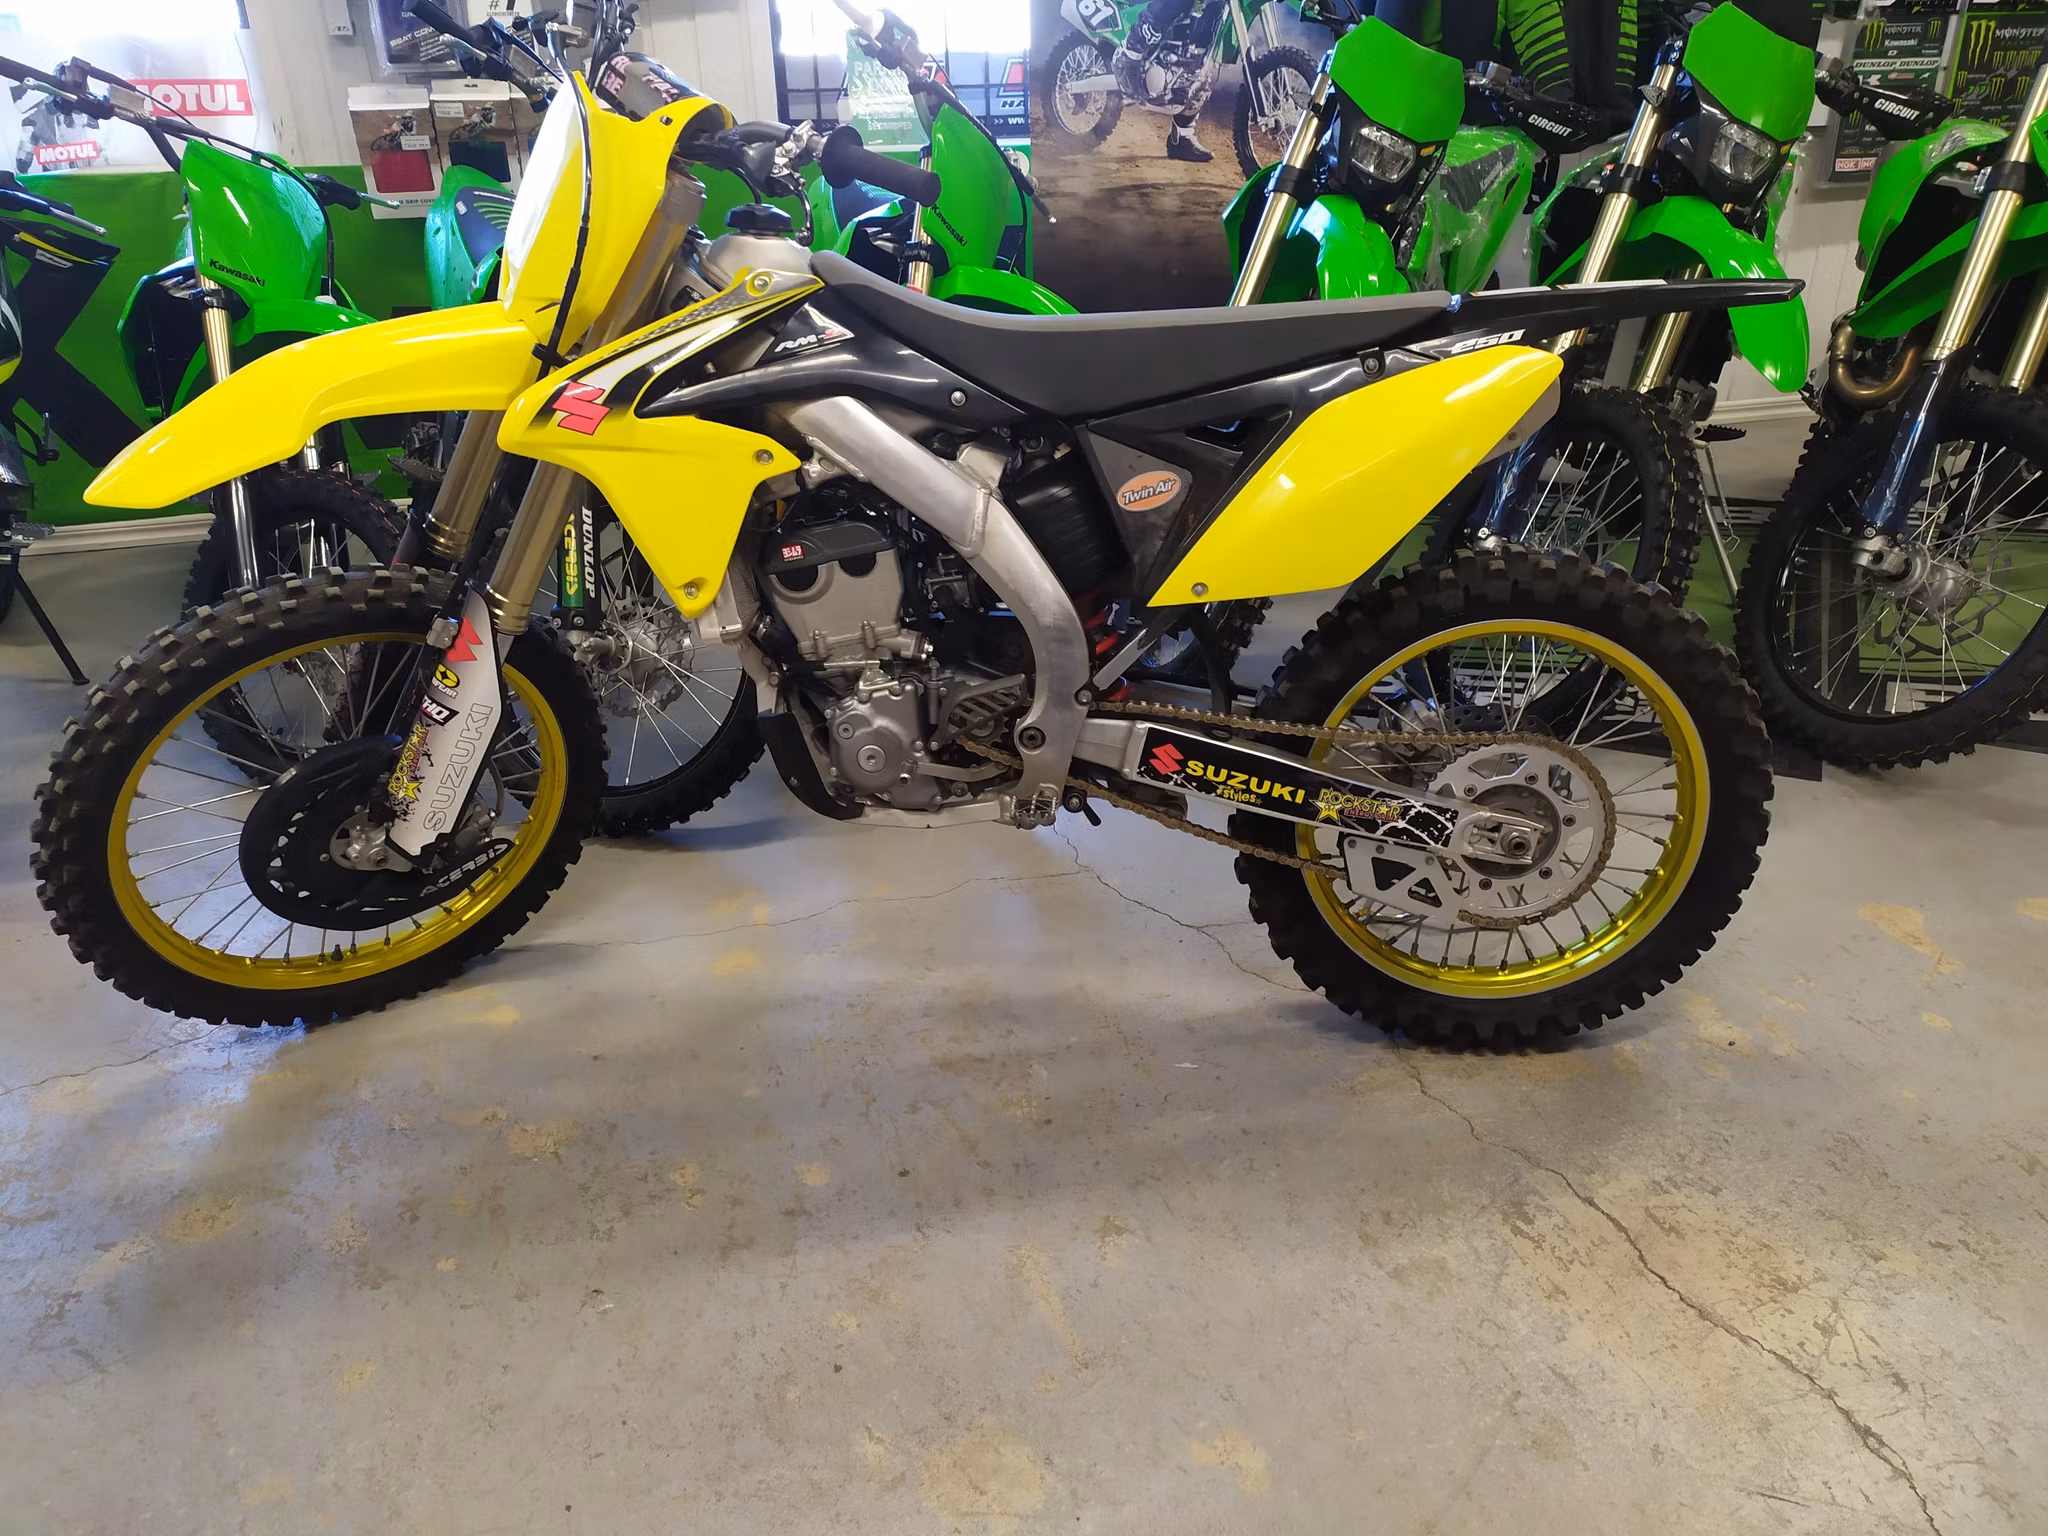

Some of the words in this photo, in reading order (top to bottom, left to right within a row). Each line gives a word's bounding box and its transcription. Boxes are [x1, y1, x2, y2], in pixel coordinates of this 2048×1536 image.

[1884, 38, 1918, 47] Kawasaki
[1855, 60, 1897, 69] DUNLOP
[1899, 59, 1940, 68] DUNLOP
[143, 83, 246, 112] MOTUL
[1873, 98, 1920, 121] CIRCUIT
[1528, 113, 1573, 138] CIRCUIT
[39, 142, 97, 163] MOTUL
[1837, 160, 1857, 169] NGK
[932, 204, 968, 247] Kawasaki
[209, 259, 265, 287] Kawasaki
[1451, 329, 1526, 354] 250
[1122, 485, 1155, 505] Twin
[1155, 478, 1175, 495] Air
[582, 505, 596, 599] DUNLOP
[423, 702, 494, 832] SUZUKI
[1185, 760, 1306, 804] SUZUKI
[420, 843, 509, 897] ACERBIS
